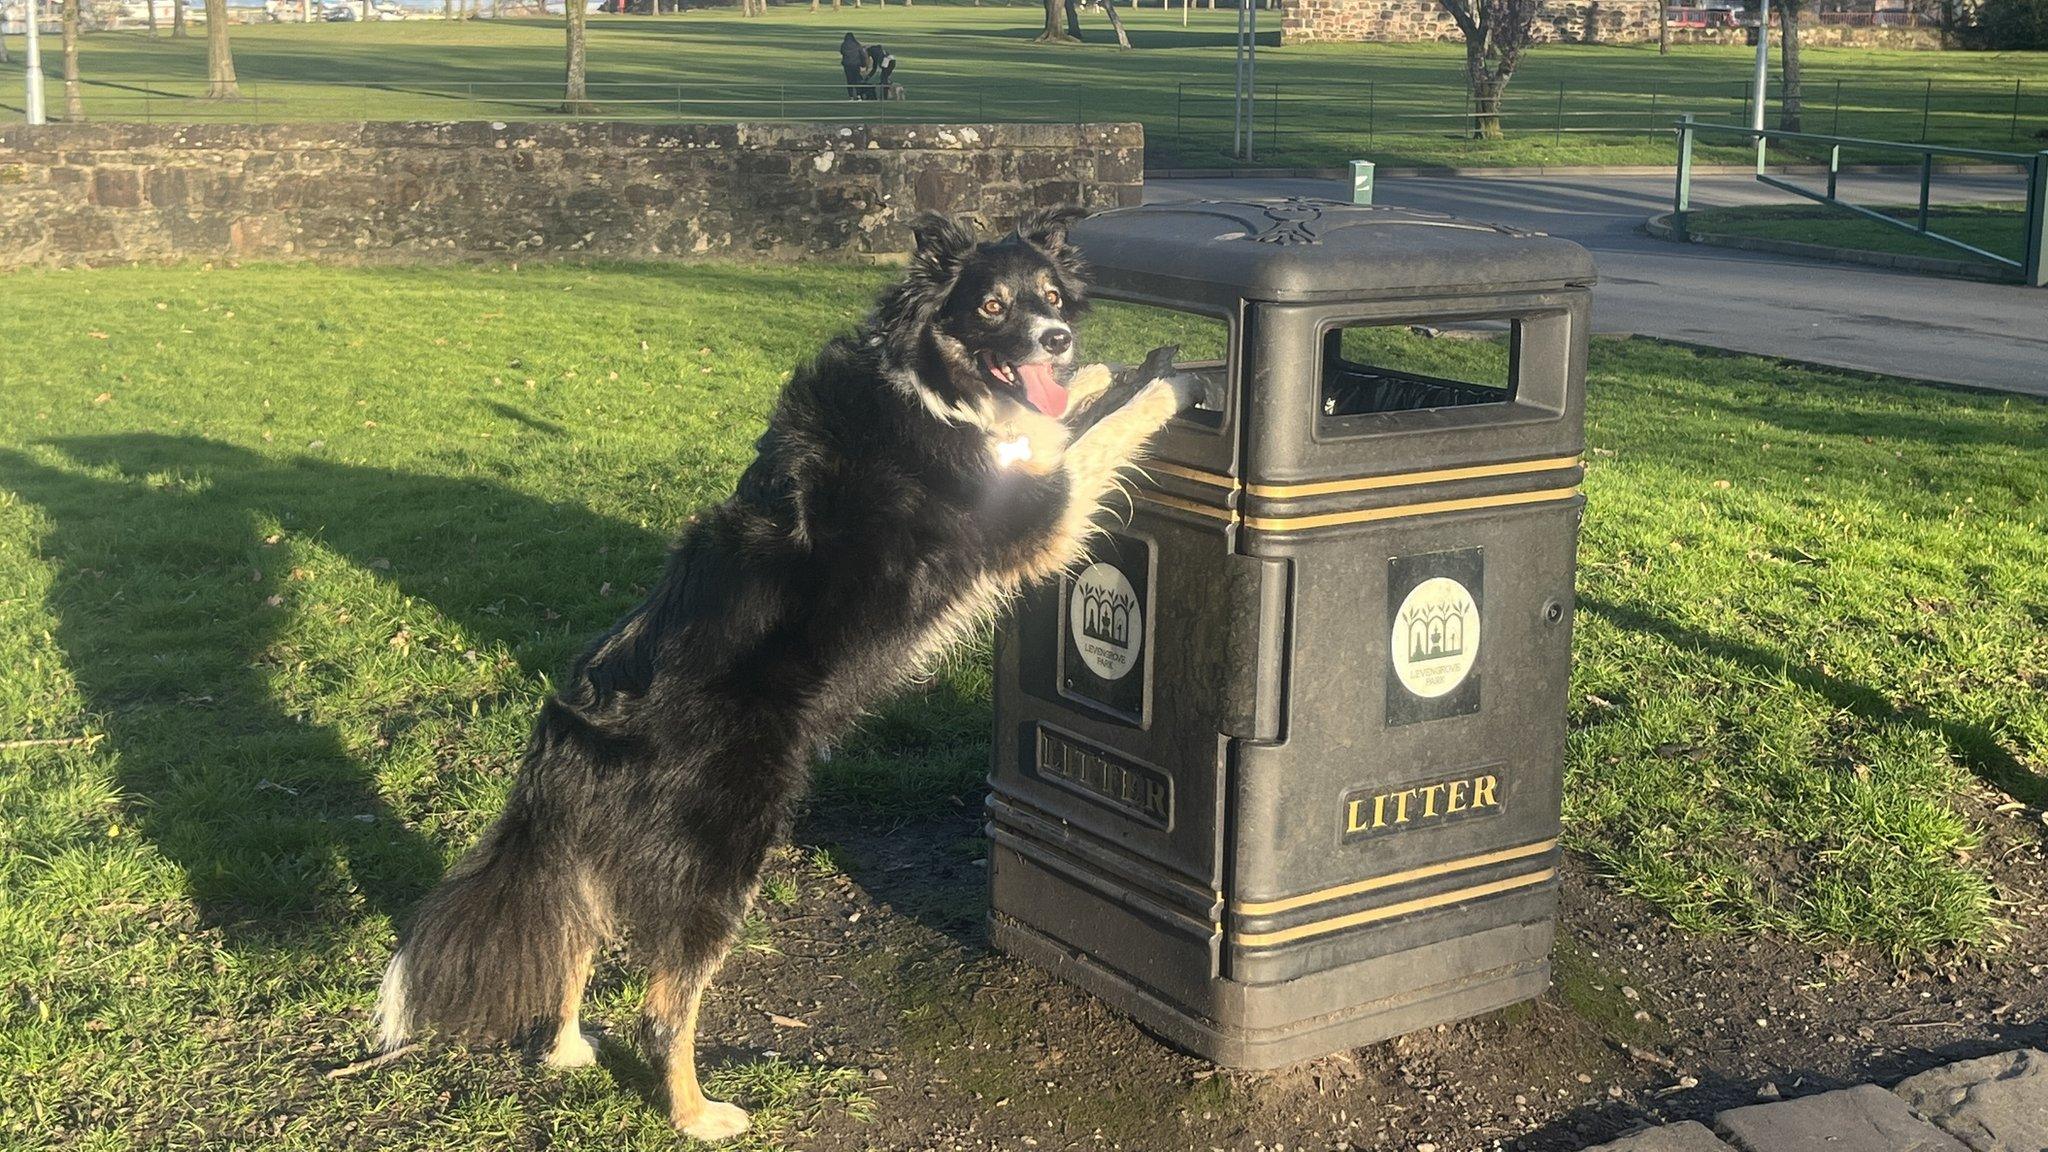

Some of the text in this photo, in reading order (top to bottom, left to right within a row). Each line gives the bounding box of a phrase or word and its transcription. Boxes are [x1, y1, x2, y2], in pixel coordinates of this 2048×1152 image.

[1096, 655, 1115, 671] PARK
[1425, 676, 1445, 687] PARK
[1041, 735, 1168, 817] LITTER
[1346, 774, 1500, 834] LITTER
